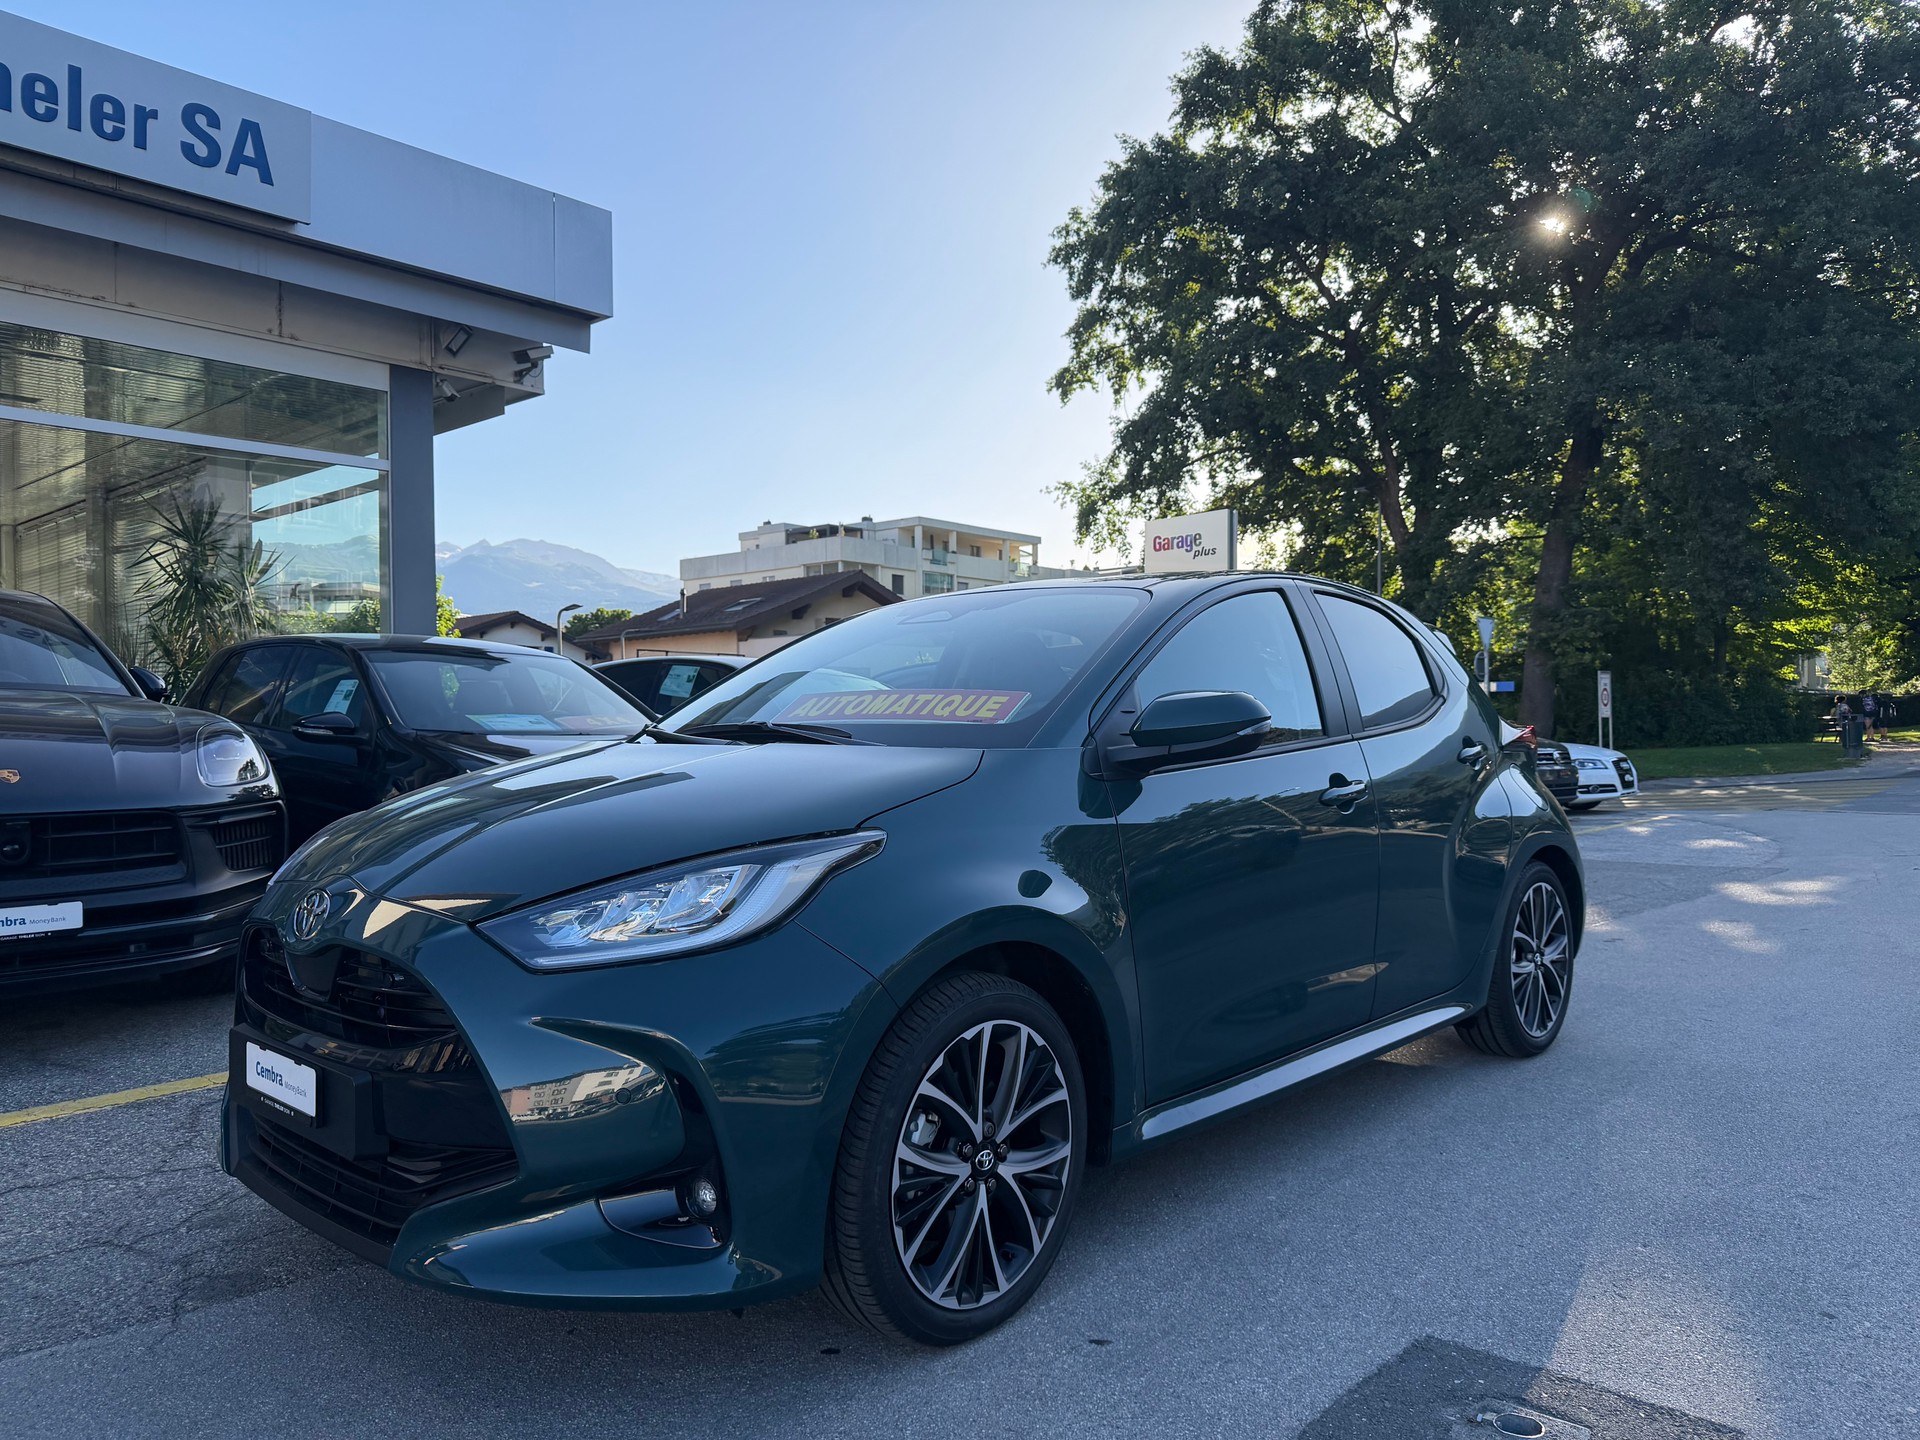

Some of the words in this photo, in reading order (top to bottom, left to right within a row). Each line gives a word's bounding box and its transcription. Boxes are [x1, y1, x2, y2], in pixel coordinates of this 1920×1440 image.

[180, 102, 274, 187] SA
[1153, 532, 1202, 553] Garage
[1192, 546, 1217, 560] plus
[788, 694, 1010, 718] AUTOMATIQUE
[29, 915, 66, 925] MoneyBank
[255, 1060, 284, 1087] Cembra
[284, 1079, 308, 1098] MoneyBank
